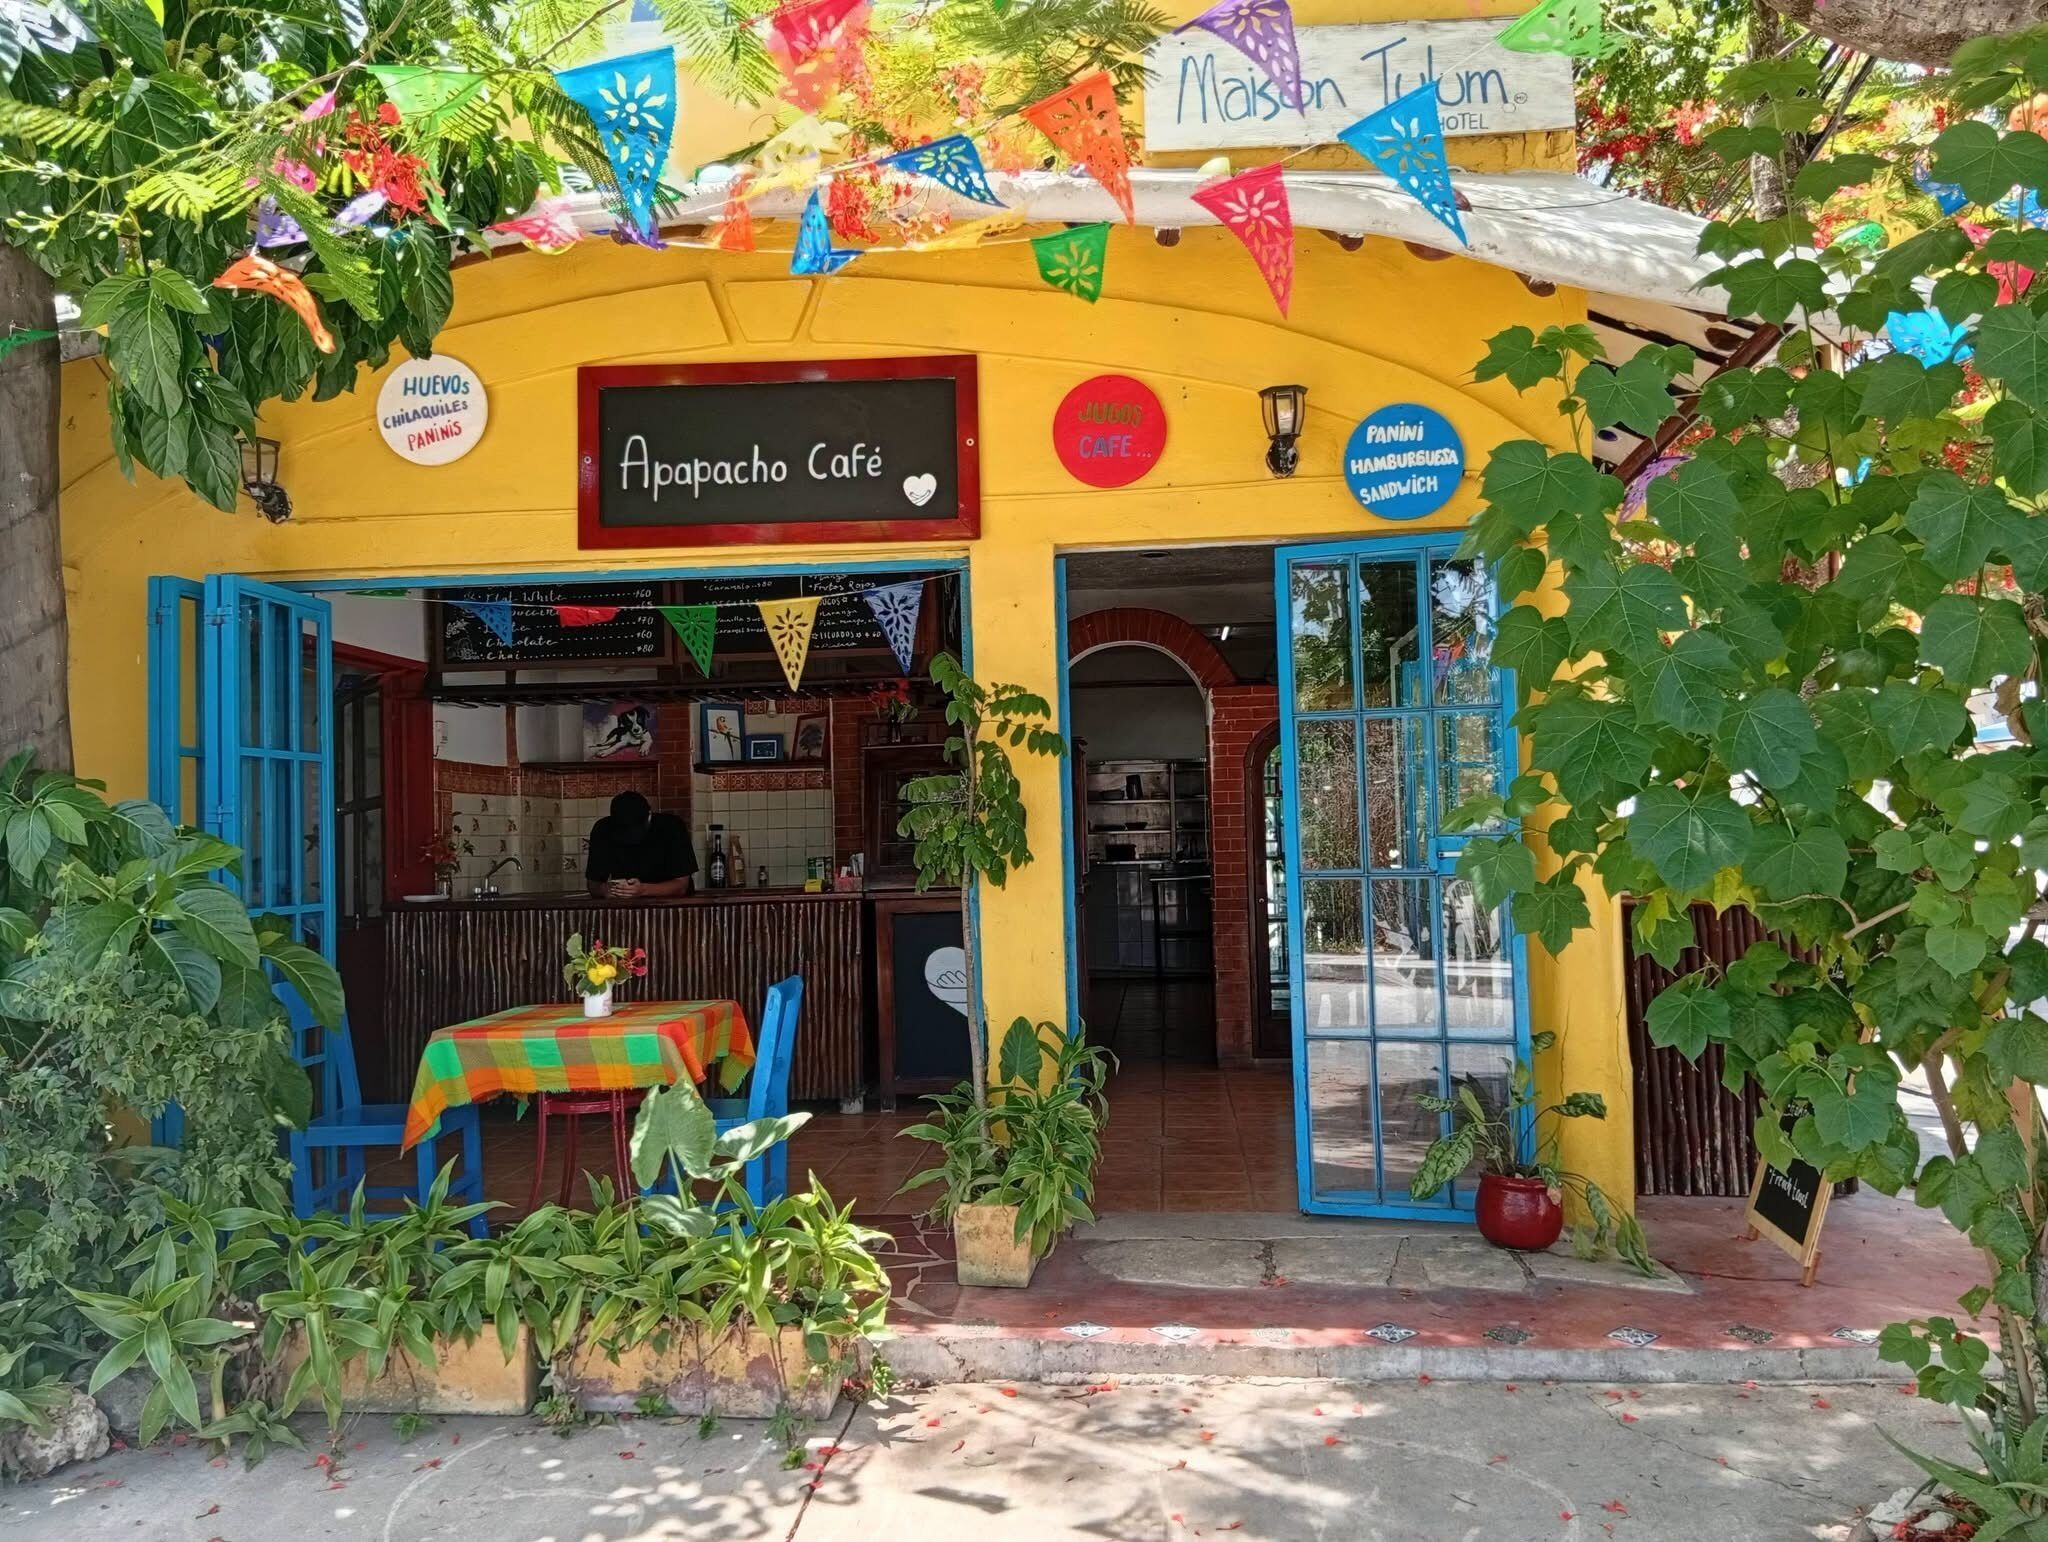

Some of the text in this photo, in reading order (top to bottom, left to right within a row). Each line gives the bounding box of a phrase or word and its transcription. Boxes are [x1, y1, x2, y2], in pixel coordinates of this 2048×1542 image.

[1177, 53, 1347, 125] Maison
[619, 434, 882, 503] Apapacho Café
